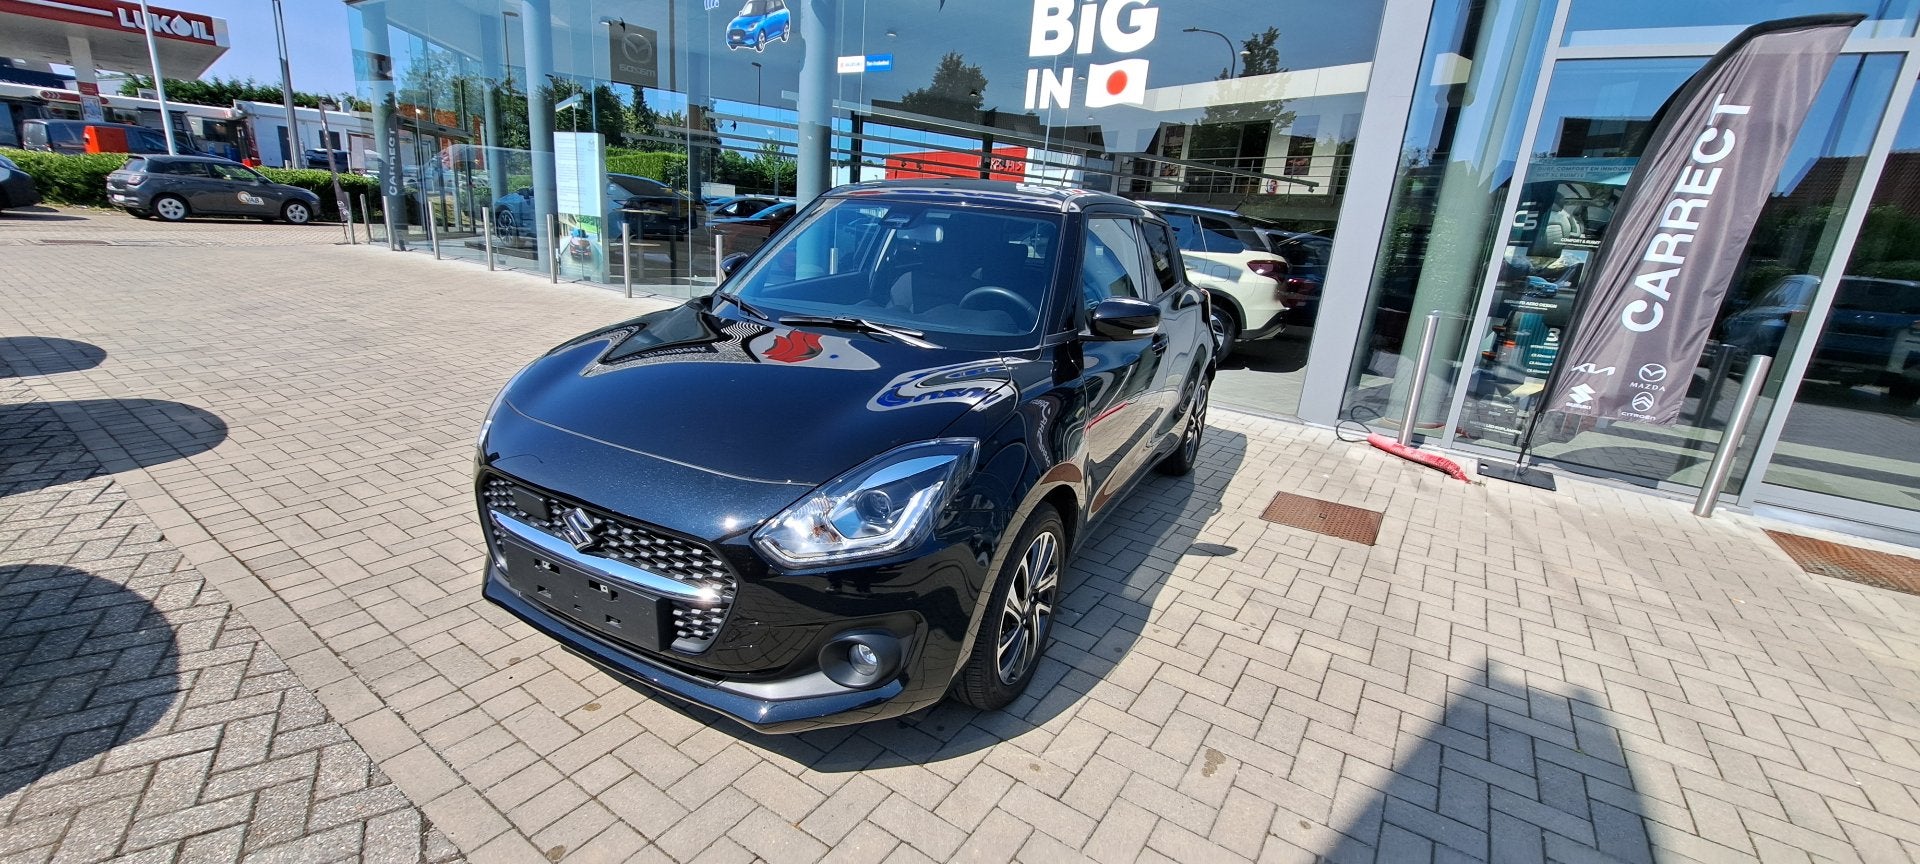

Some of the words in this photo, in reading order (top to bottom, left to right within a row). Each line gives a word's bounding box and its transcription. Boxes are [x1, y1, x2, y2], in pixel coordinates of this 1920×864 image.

[1024, 67, 1074, 110] IN
[1621, 92, 1751, 332] CARRECT
[1629, 381, 1666, 392] MAZDA
